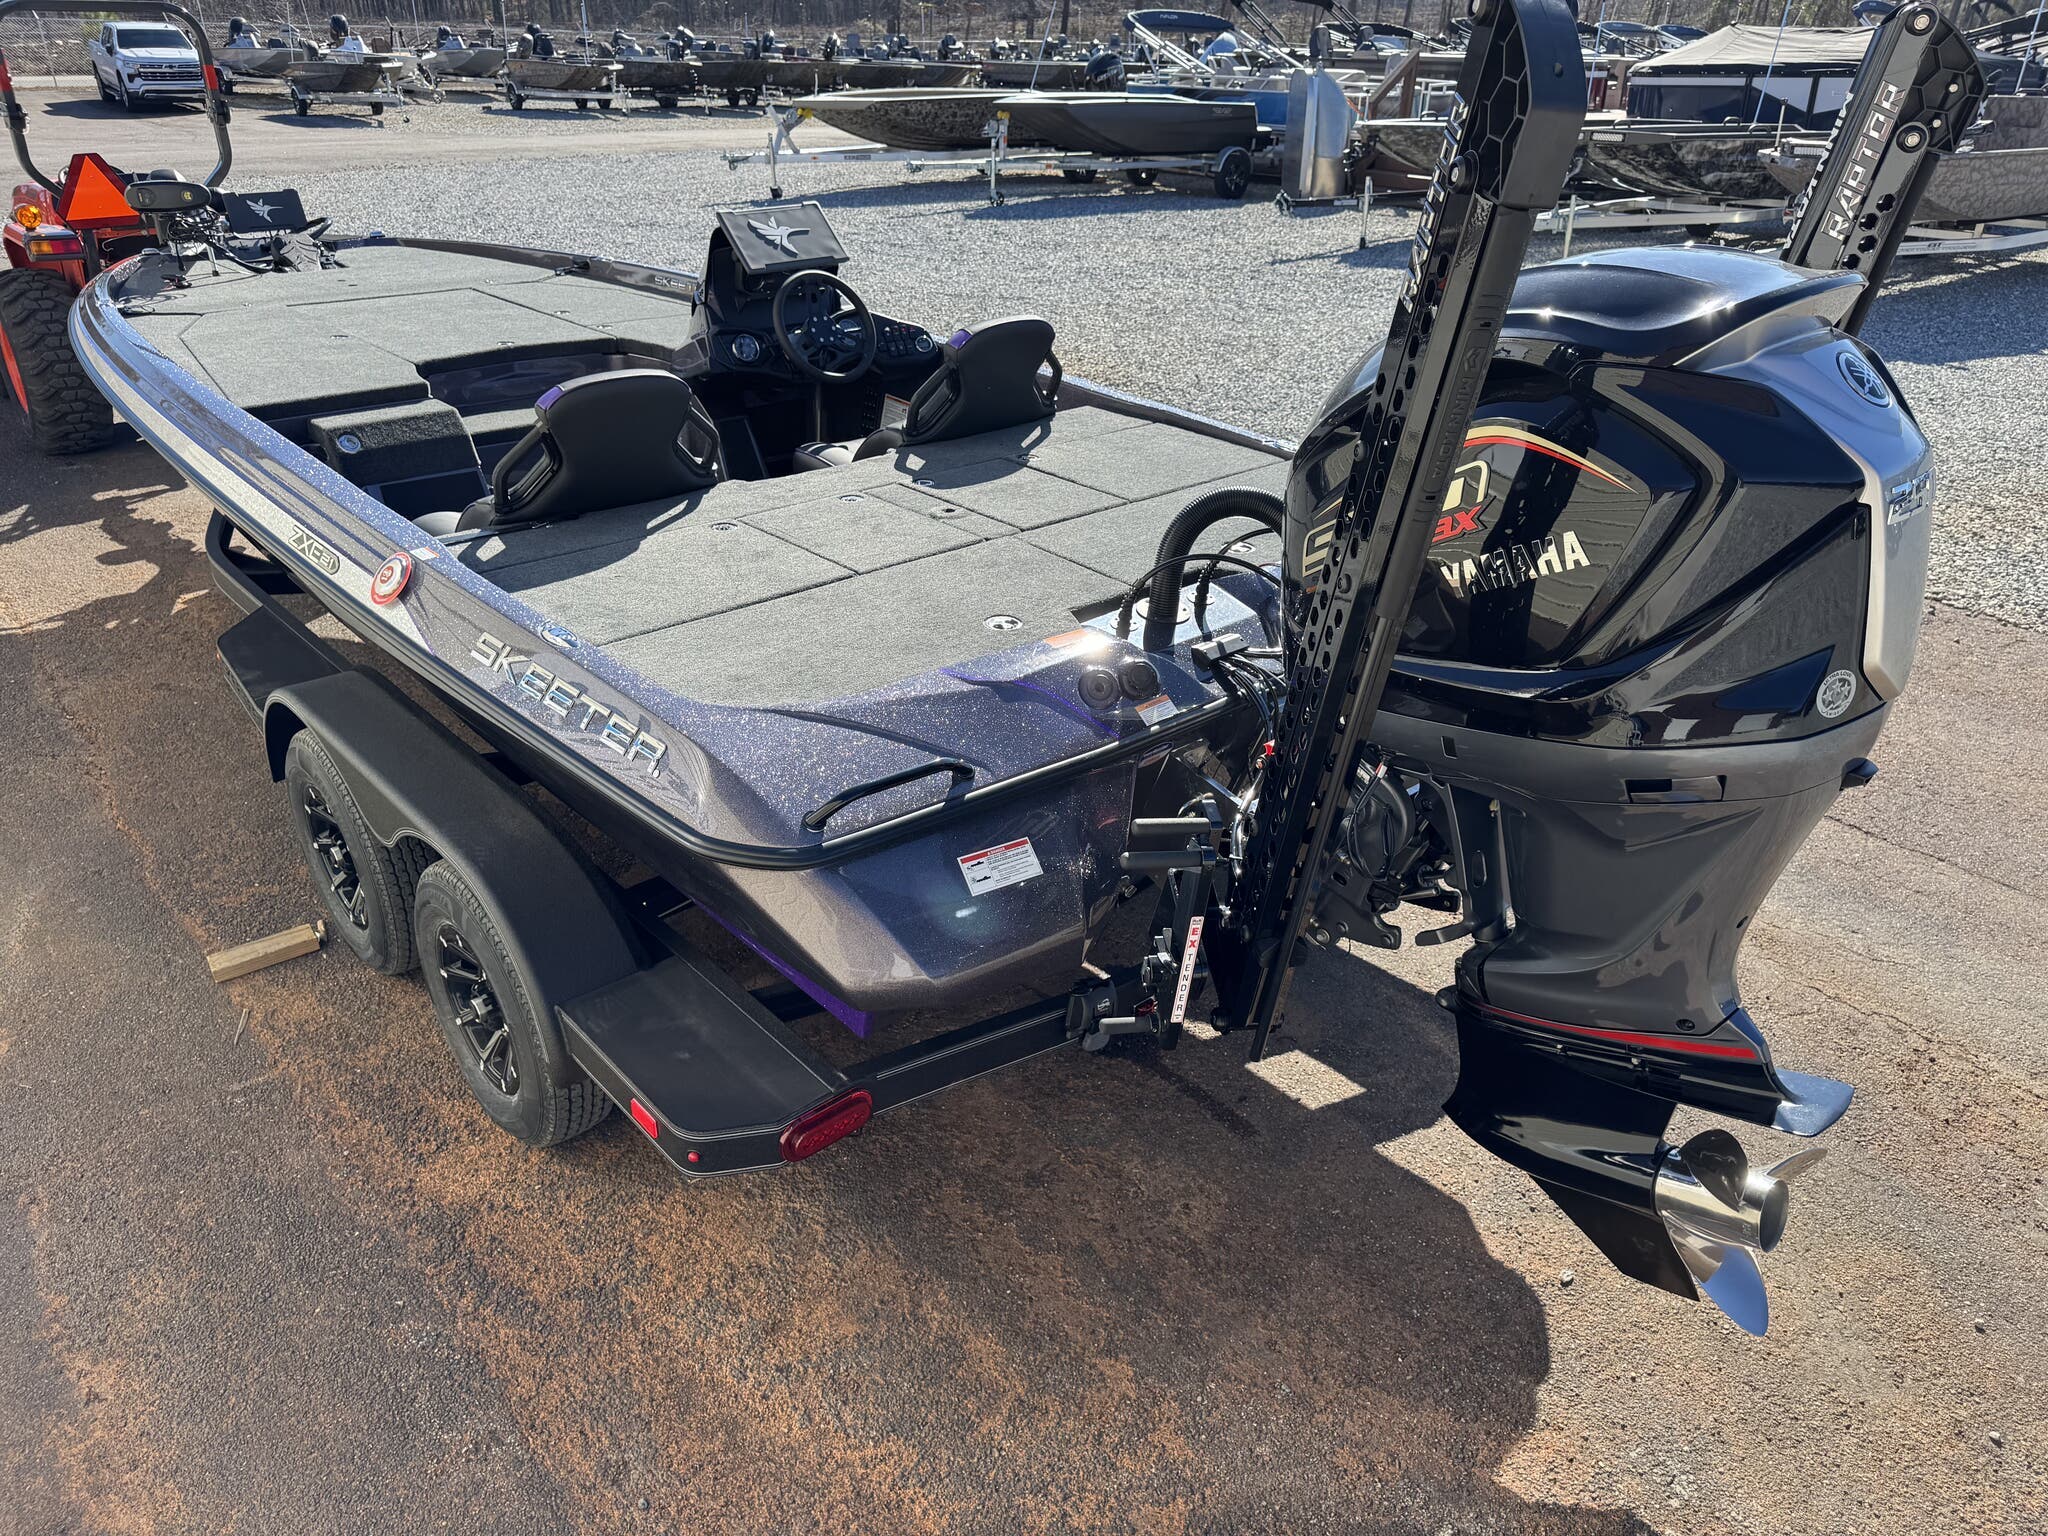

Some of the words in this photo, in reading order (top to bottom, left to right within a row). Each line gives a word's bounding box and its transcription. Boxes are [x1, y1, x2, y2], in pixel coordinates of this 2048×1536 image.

[1401, 92, 1469, 314] RAPTOR
[1820, 80, 1906, 241] RAPTOR
[1440, 530, 1591, 599] YAMAHA
[470, 632, 667, 773] SKEETER
